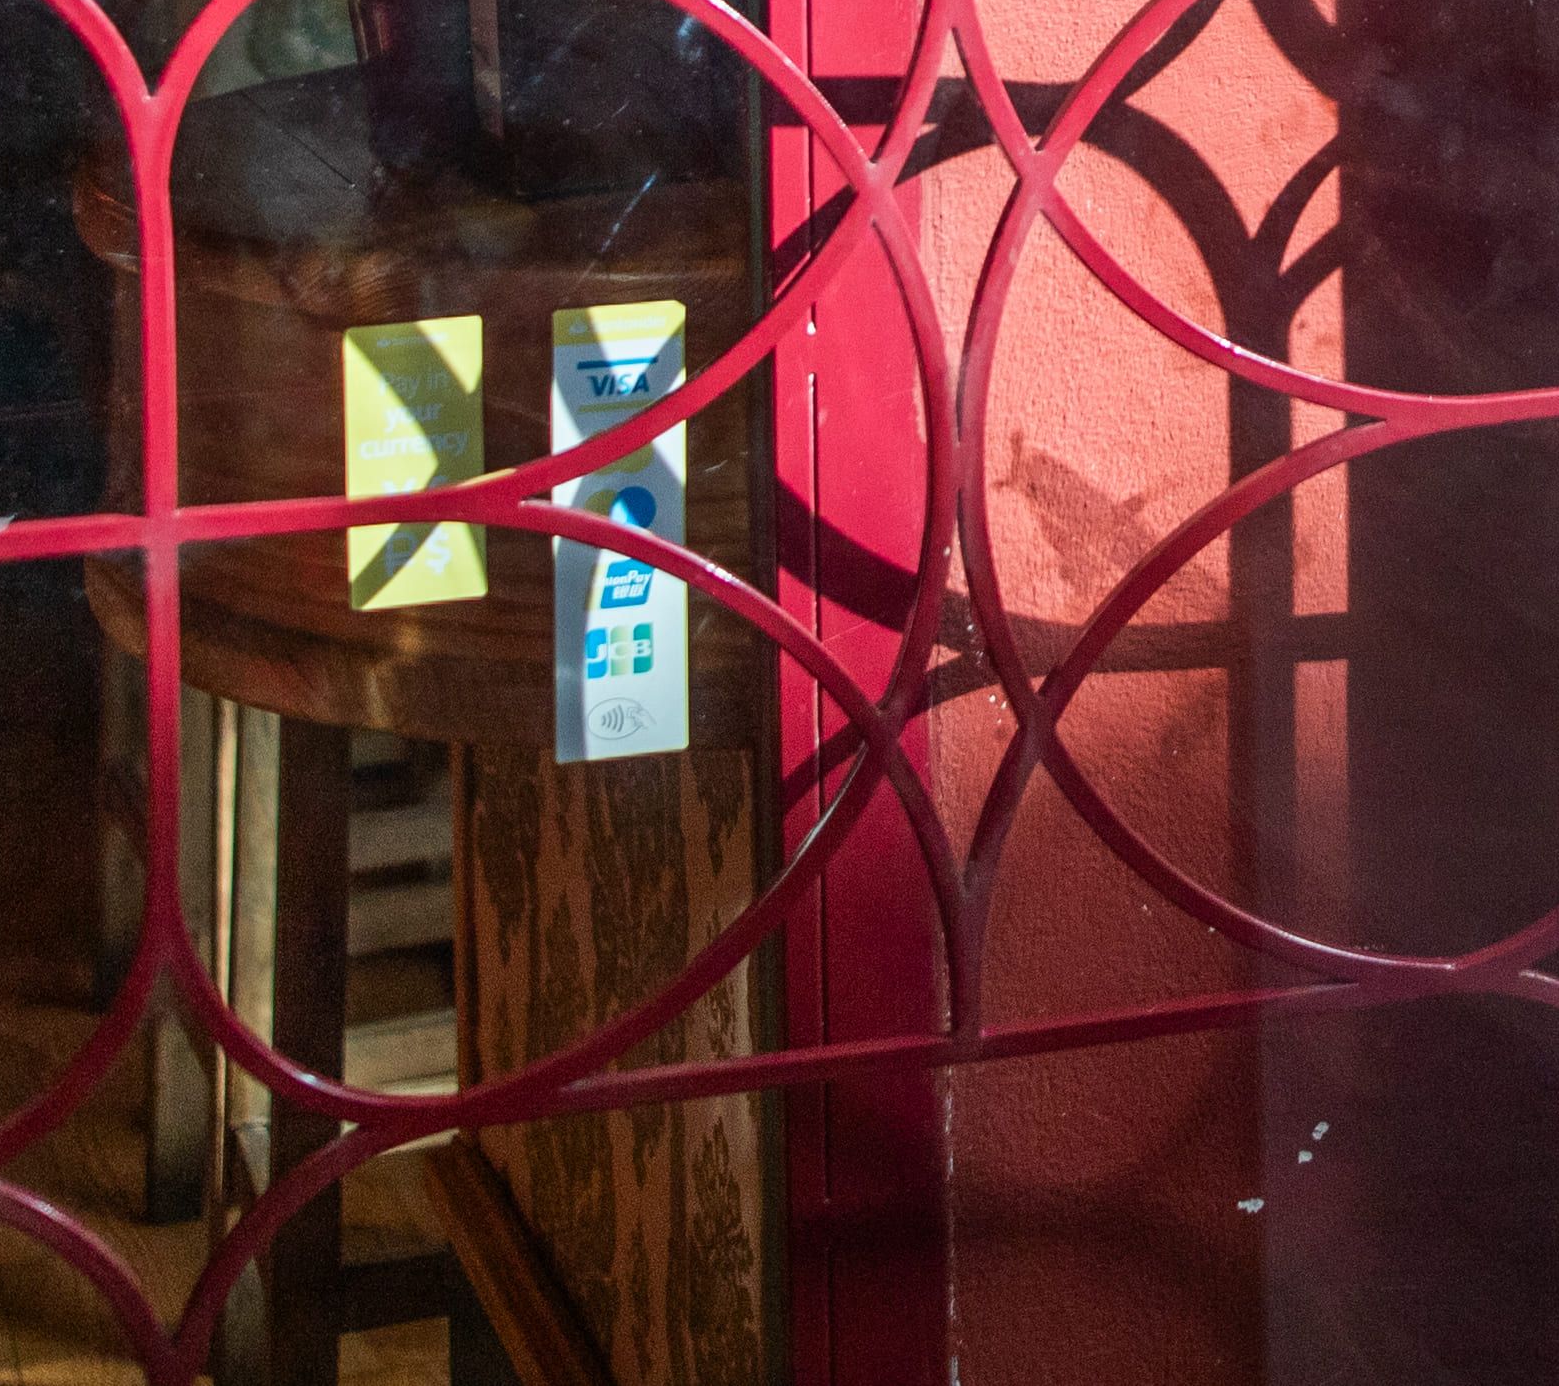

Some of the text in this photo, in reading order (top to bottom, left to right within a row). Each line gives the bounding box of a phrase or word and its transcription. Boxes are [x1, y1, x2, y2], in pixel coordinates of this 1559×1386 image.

[379, 373, 420, 399] Pay
[589, 373, 650, 397] VISA
[384, 403, 443, 433] your
[359, 432, 469, 460] currency
[584, 638, 652, 664] JCB
